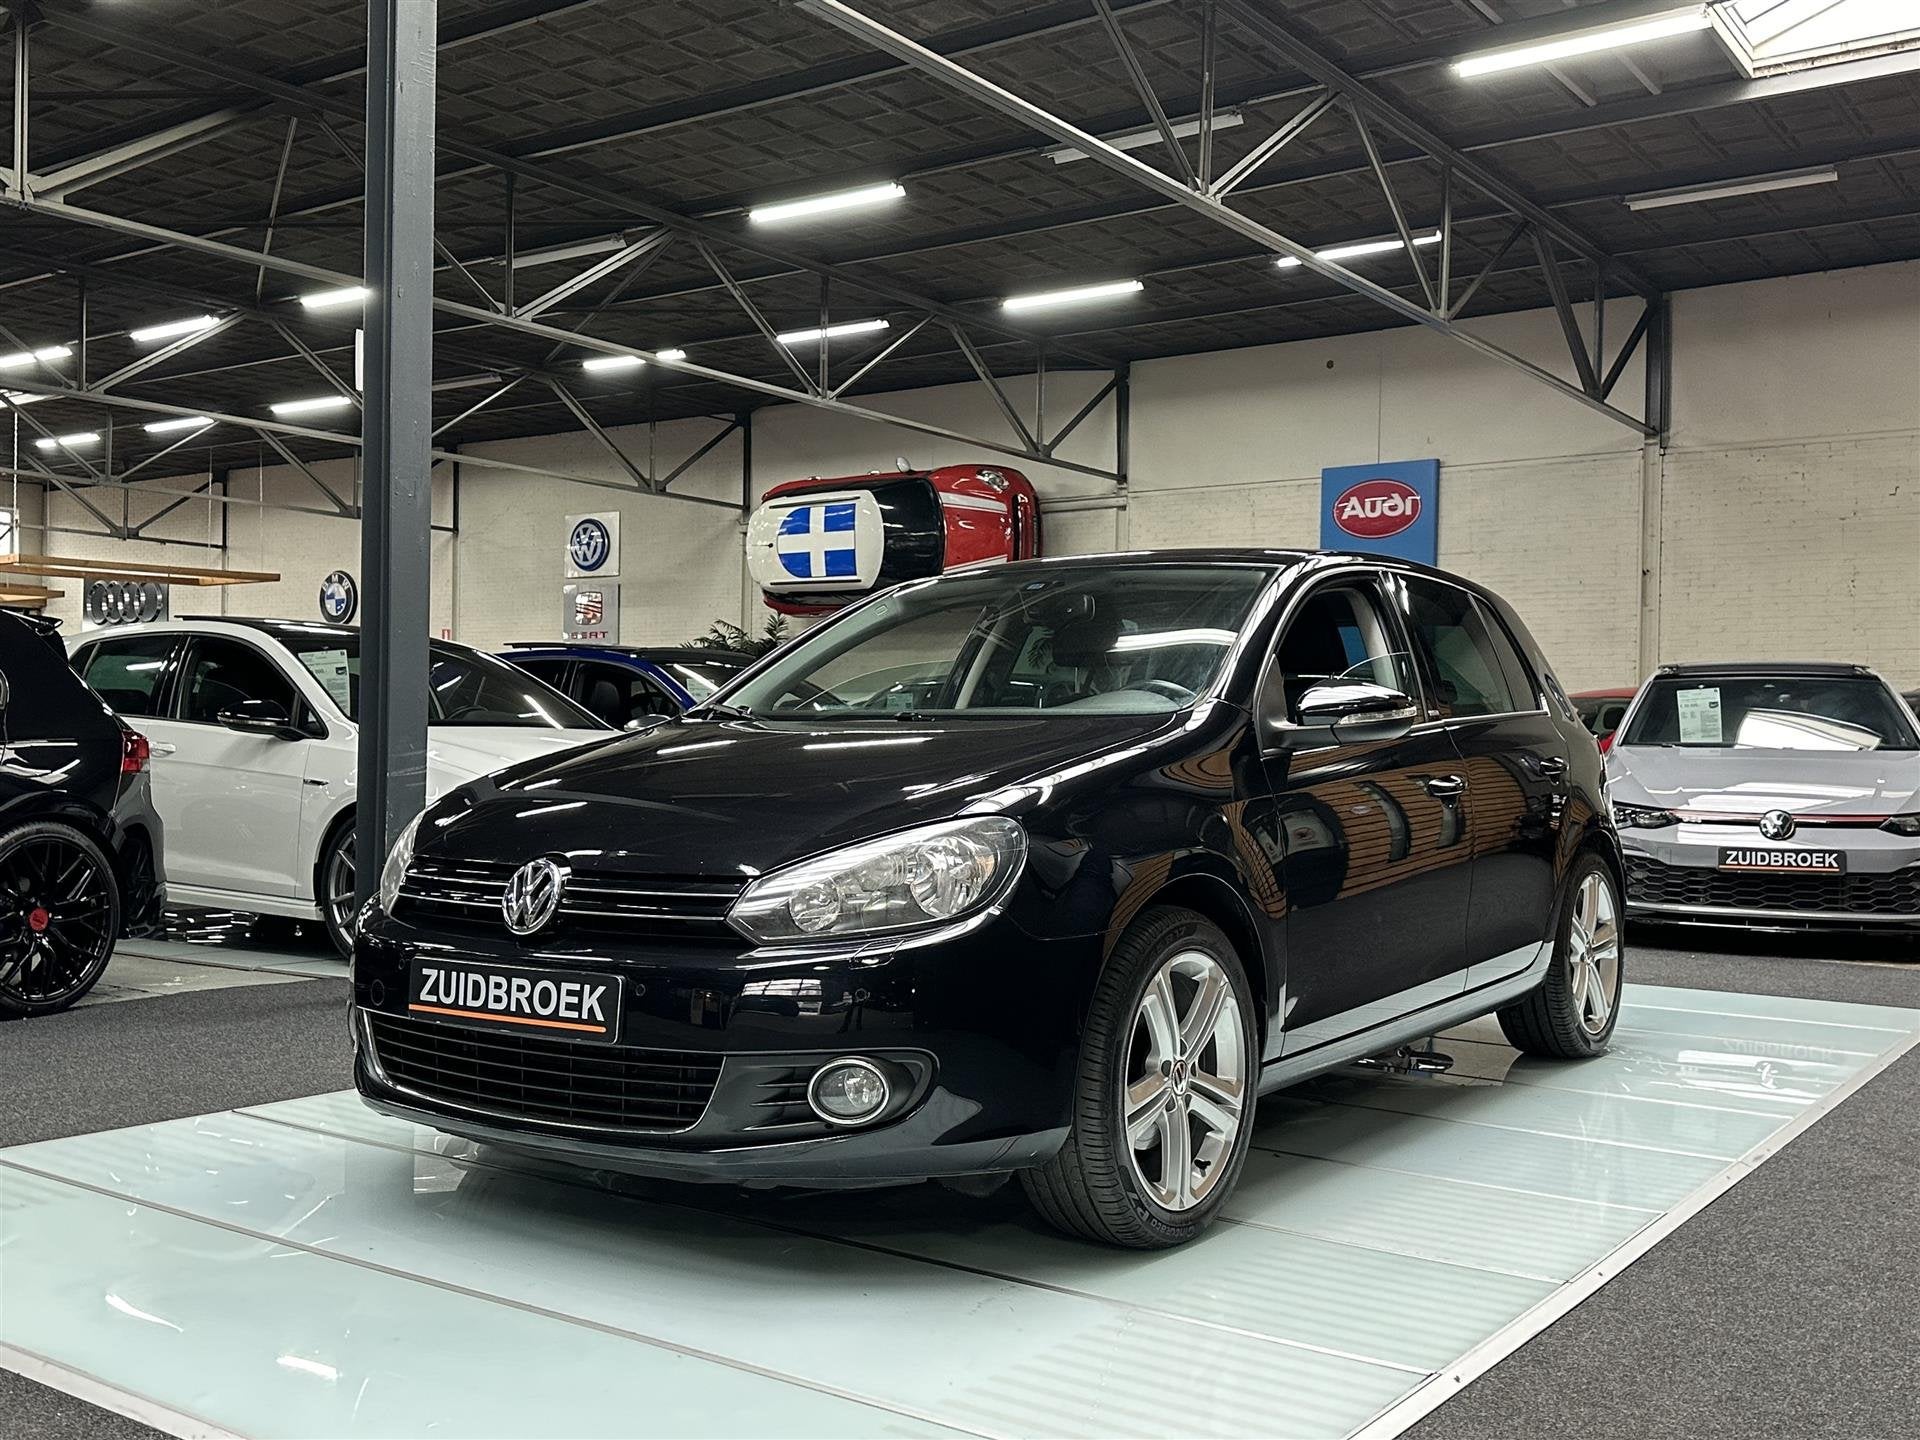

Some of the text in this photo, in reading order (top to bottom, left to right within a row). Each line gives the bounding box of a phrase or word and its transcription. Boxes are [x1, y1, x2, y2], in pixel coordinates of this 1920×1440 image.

[322, 574, 351, 592] BMW
[571, 630, 609, 640] SEAT
[1725, 850, 1839, 867] ZUIDBROEK
[420, 968, 607, 1021] ZUIDBROEK
